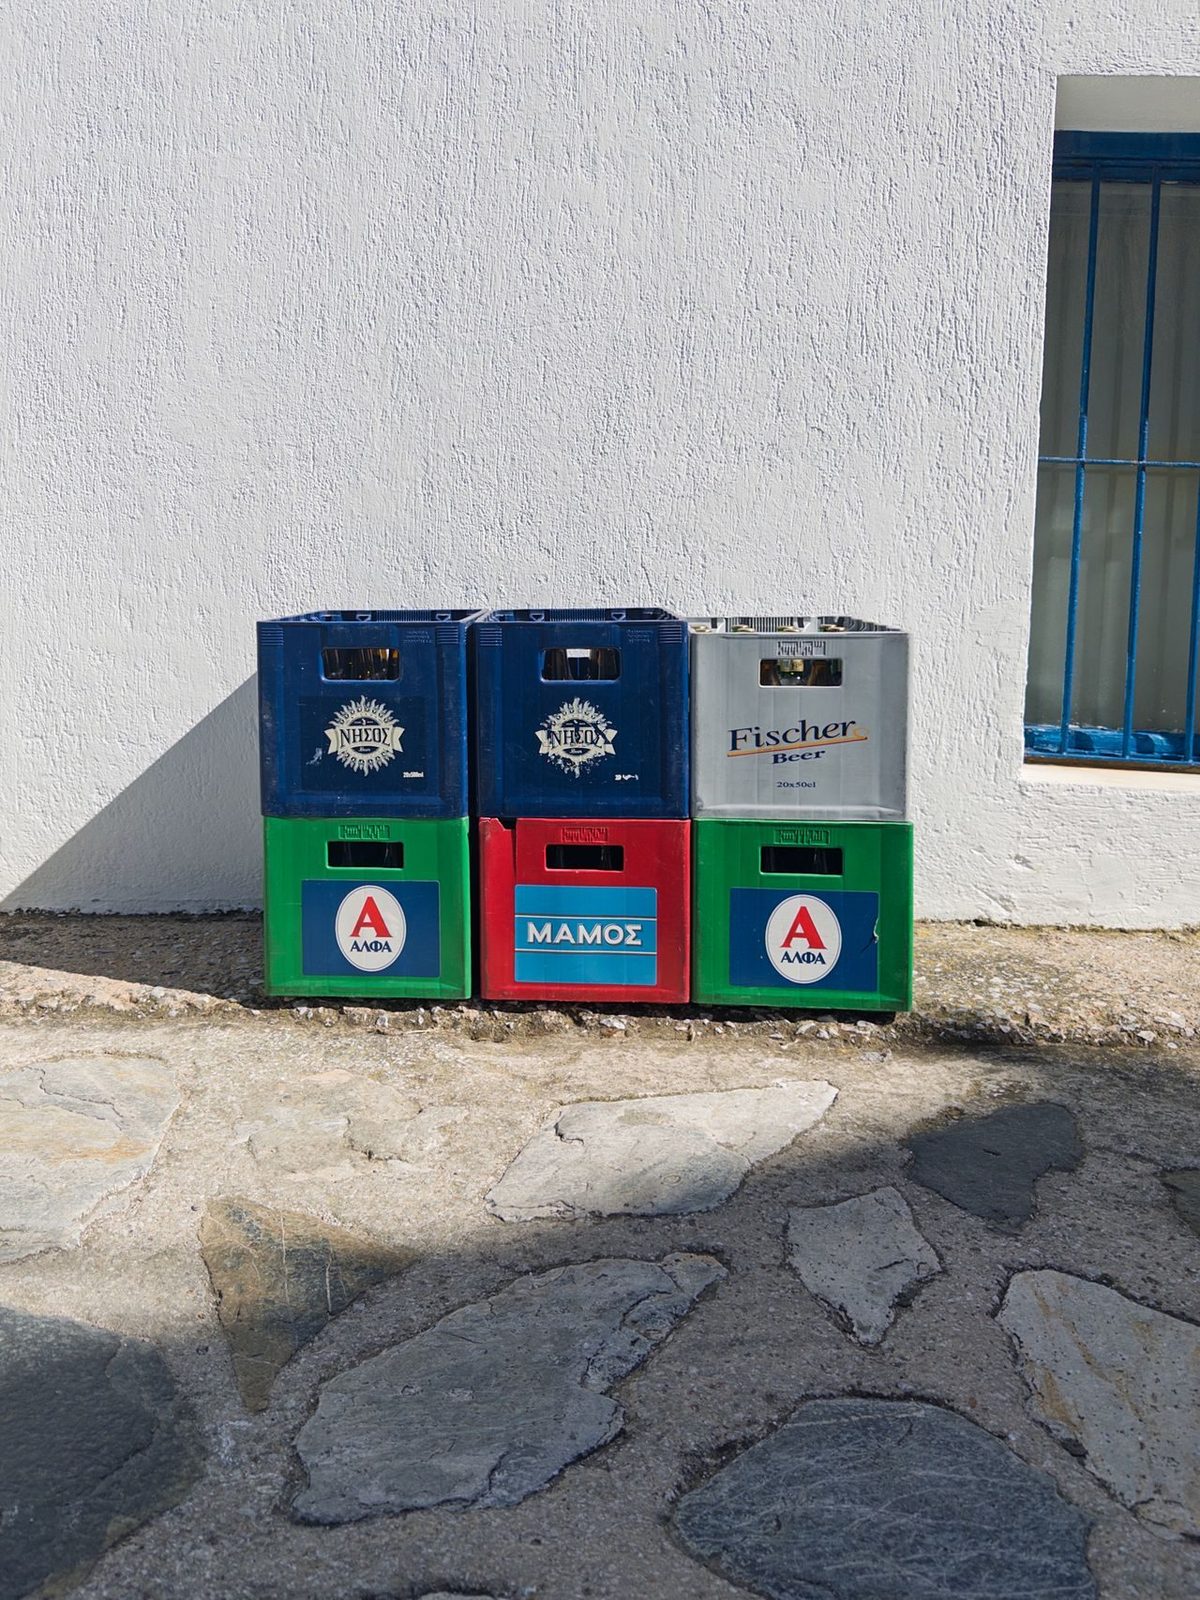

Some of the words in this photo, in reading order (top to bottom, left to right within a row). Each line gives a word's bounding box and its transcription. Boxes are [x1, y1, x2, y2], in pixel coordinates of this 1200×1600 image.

[340, 727, 390, 747] ΝΗΣΟΣ
[728, 720, 856, 751] Fischer
[772, 750, 826, 764] Beer
[527, 922, 642, 946] ΜΑΜΟΣ
[350, 940, 392, 952] ΑΛΦΑ
[780, 951, 826, 965] ΑΛΦΑ
